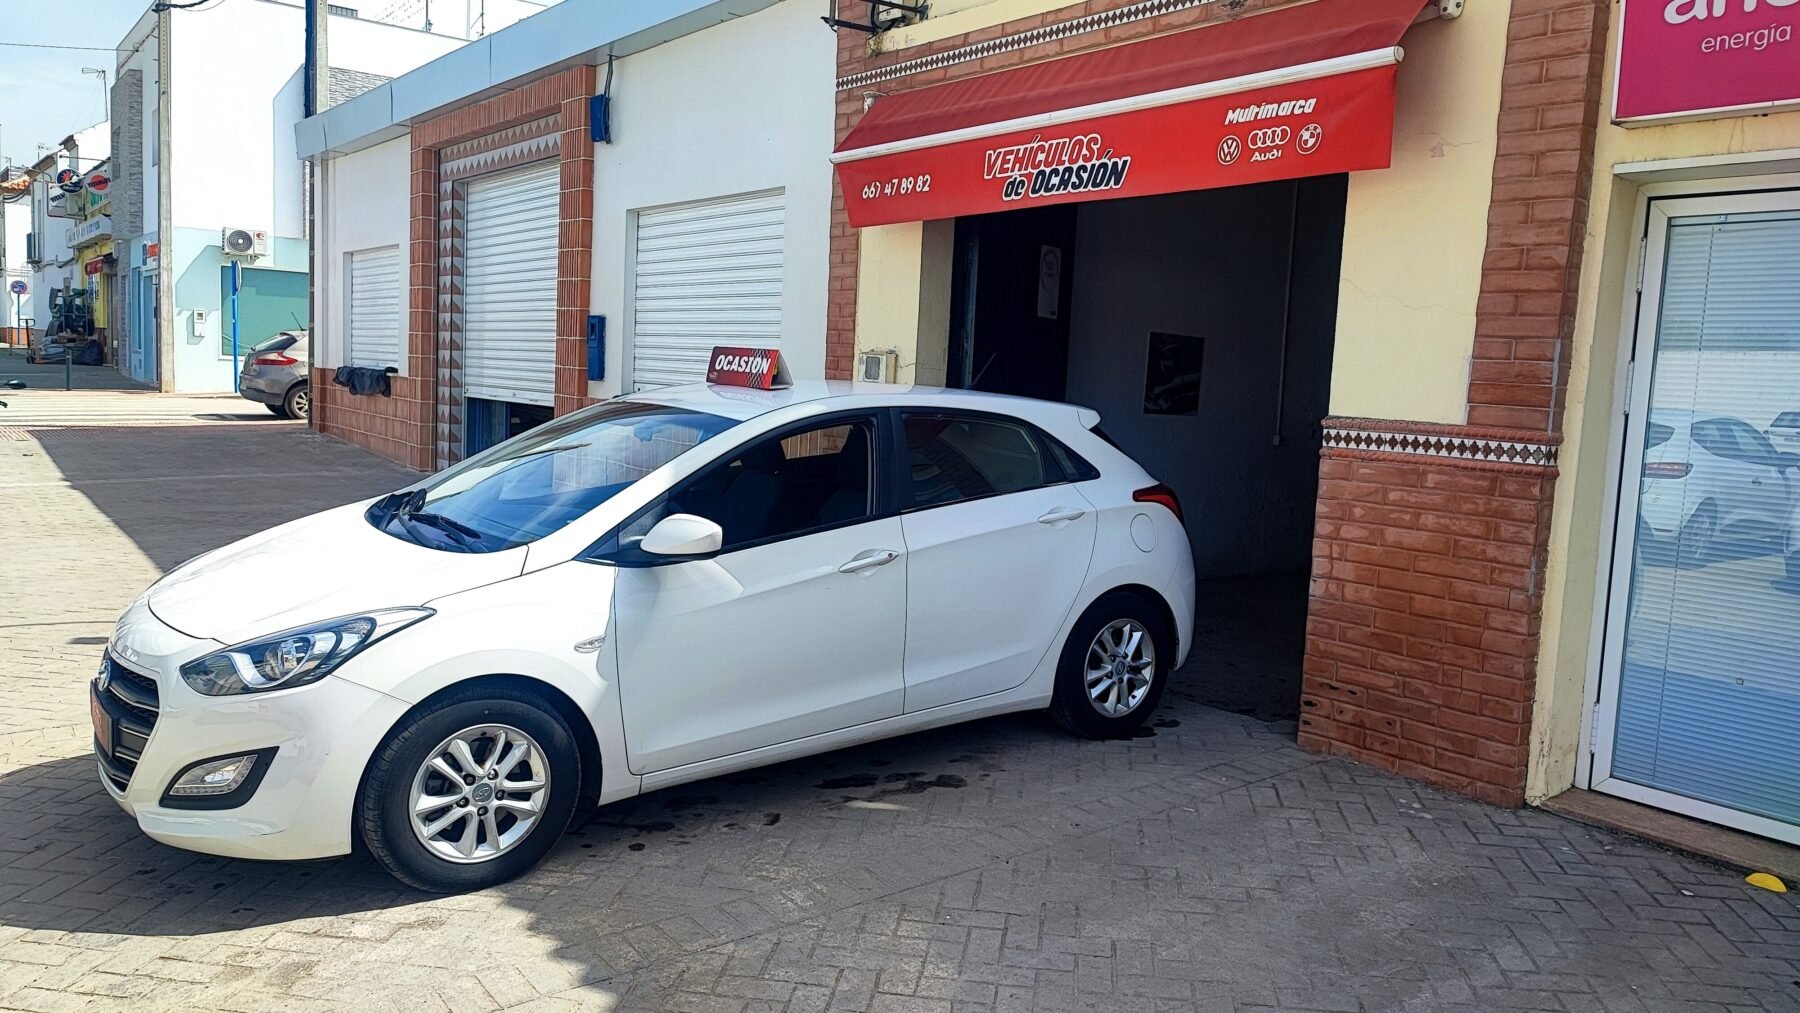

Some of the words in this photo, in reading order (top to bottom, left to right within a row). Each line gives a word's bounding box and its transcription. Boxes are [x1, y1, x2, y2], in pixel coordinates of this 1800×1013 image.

[1663, 0, 1800, 25] an
[1701, 23, 1792, 53] energía
[984, 133, 1102, 180] VEHÍCULOS
[1250, 149, 1282, 162] Audi
[884, 178, 899, 196] 47
[900, 176, 914, 195] 89
[916, 174, 931, 193] 82
[1003, 174, 1028, 200] de
[1030, 149, 1131, 197] OCASIÓN
